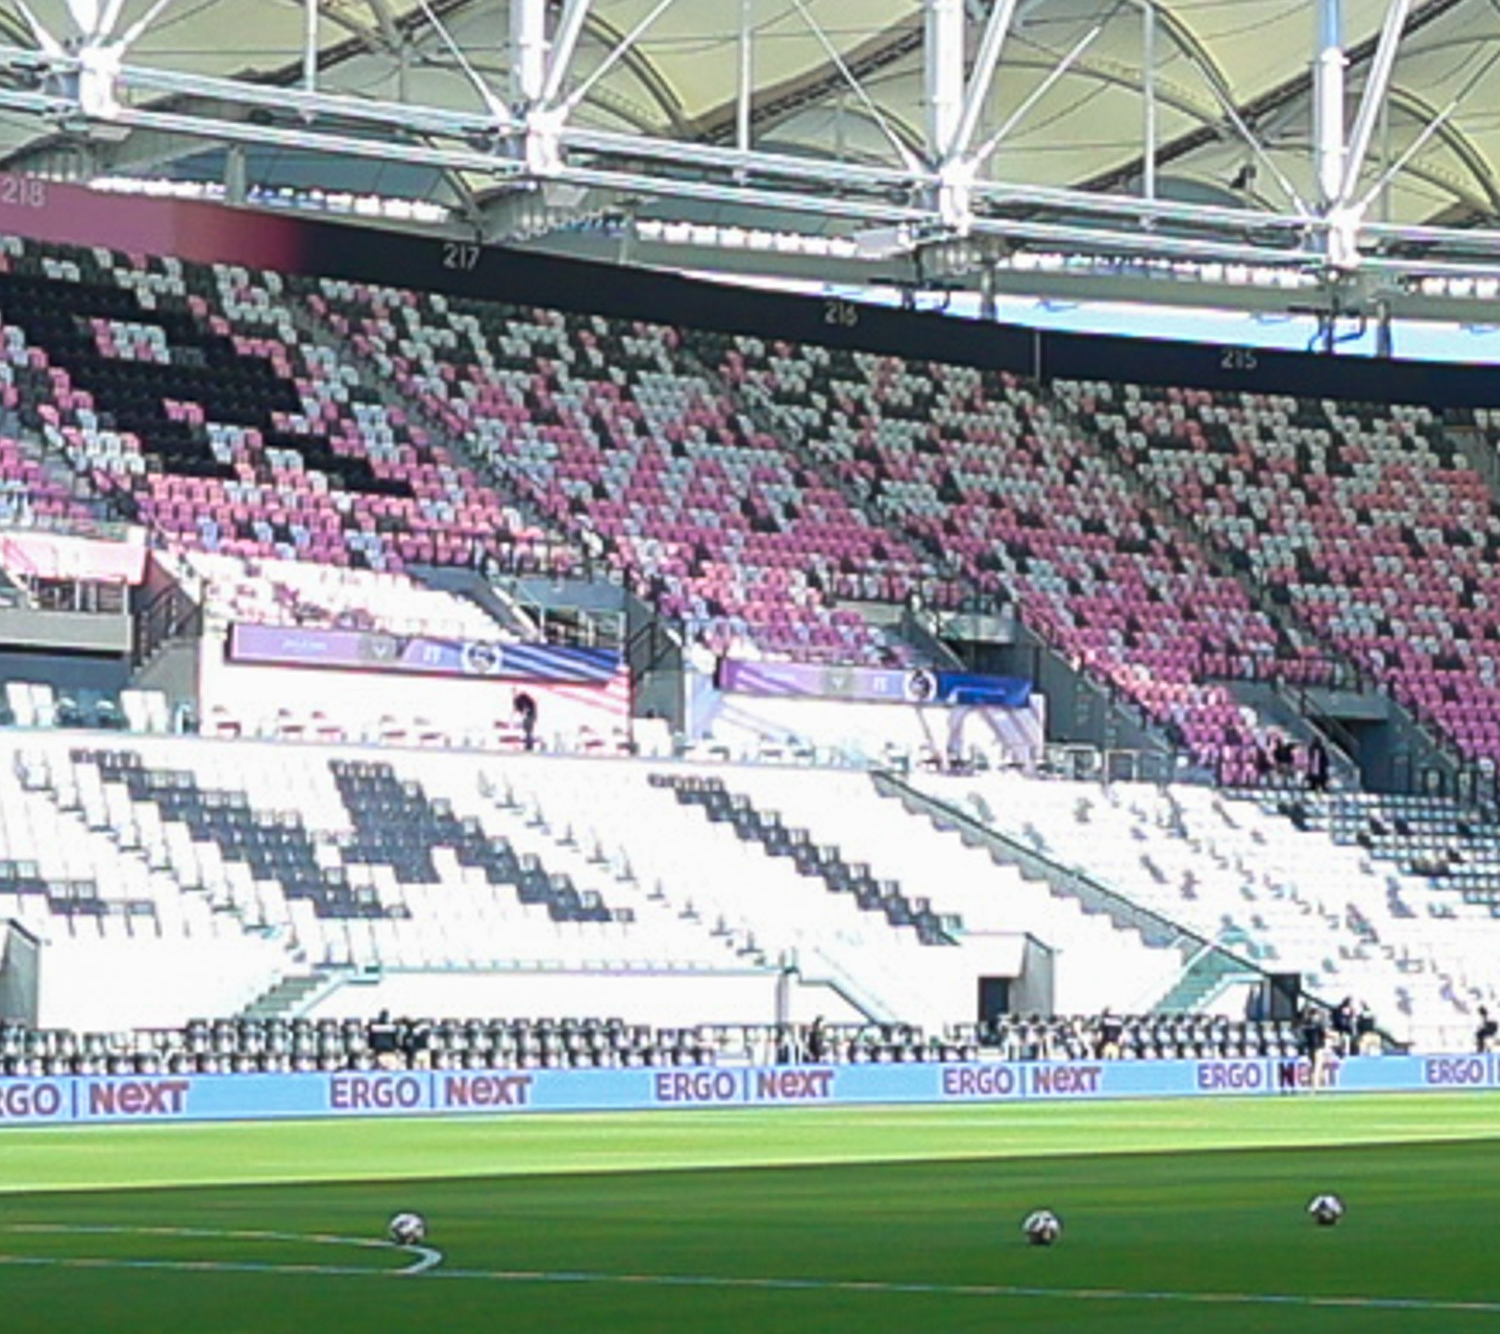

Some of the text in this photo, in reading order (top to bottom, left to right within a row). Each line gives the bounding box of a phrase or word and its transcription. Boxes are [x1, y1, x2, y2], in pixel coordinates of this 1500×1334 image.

[2, 180, 45, 207] 218
[443, 242, 479, 271] 217
[1221, 348, 1257, 369] 215
[943, 1067, 1015, 1094] ERGO
[1198, 1062, 1261, 1087] ERGO
[1426, 1058, 1484, 1083] ERGO
[330, 1077, 421, 1108] ERGO
[655, 1071, 736, 1100] ERGO
[0, 1083, 60, 1116] GO
